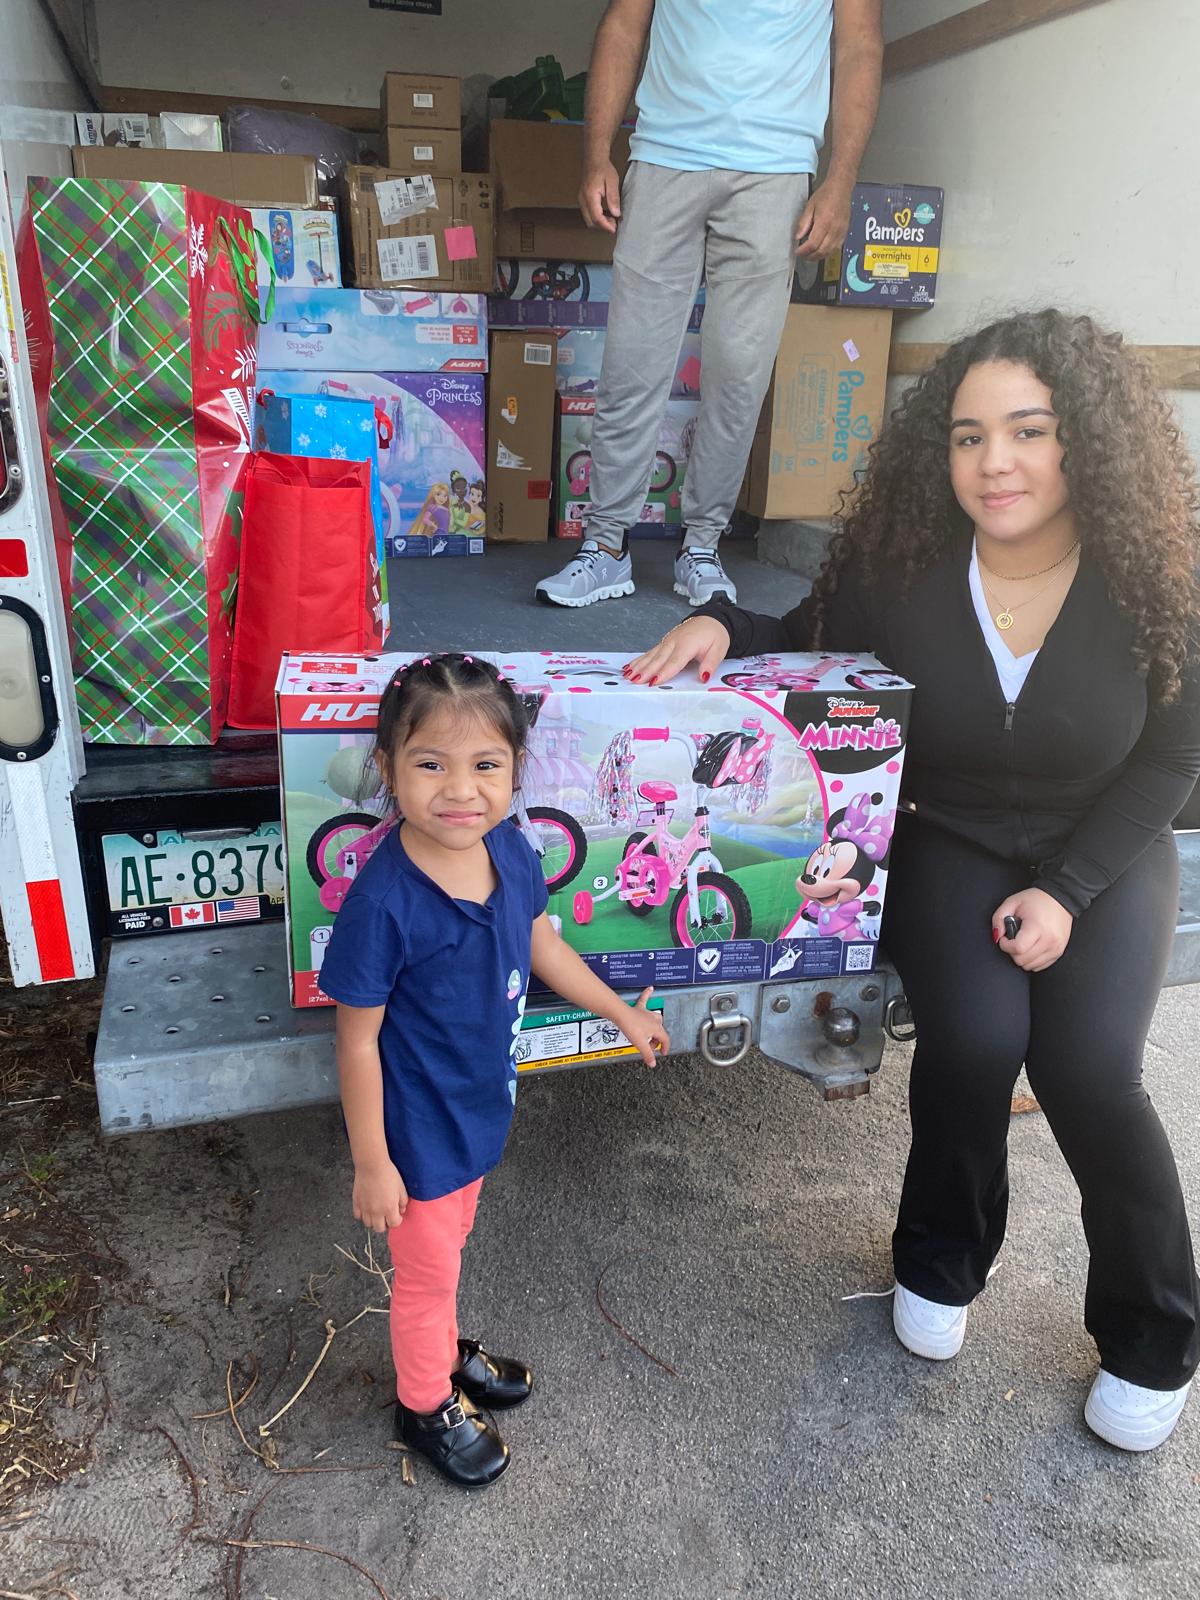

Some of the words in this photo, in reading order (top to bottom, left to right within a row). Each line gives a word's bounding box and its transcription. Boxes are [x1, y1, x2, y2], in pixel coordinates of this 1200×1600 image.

[865, 216, 925, 245] Pampers
[871, 251, 912, 262] overnights
[923, 254, 930, 264] 6
[426, 388, 482, 407] PRINCESS
[567, 402, 596, 411] HUF
[832, 370, 865, 462] Pampers
[827, 696, 865, 709] Disney
[300, 702, 380, 722] HUF
[797, 719, 902, 751] MINNIE
[597, 879, 604, 887] 3
[125, 921, 146, 930] PAID
[318, 932, 324, 940] 1
[601, 955, 608, 963] 2
[648, 952, 655, 960] 3
[546, 1011, 592, 1024] SAFETY-CHAIN
